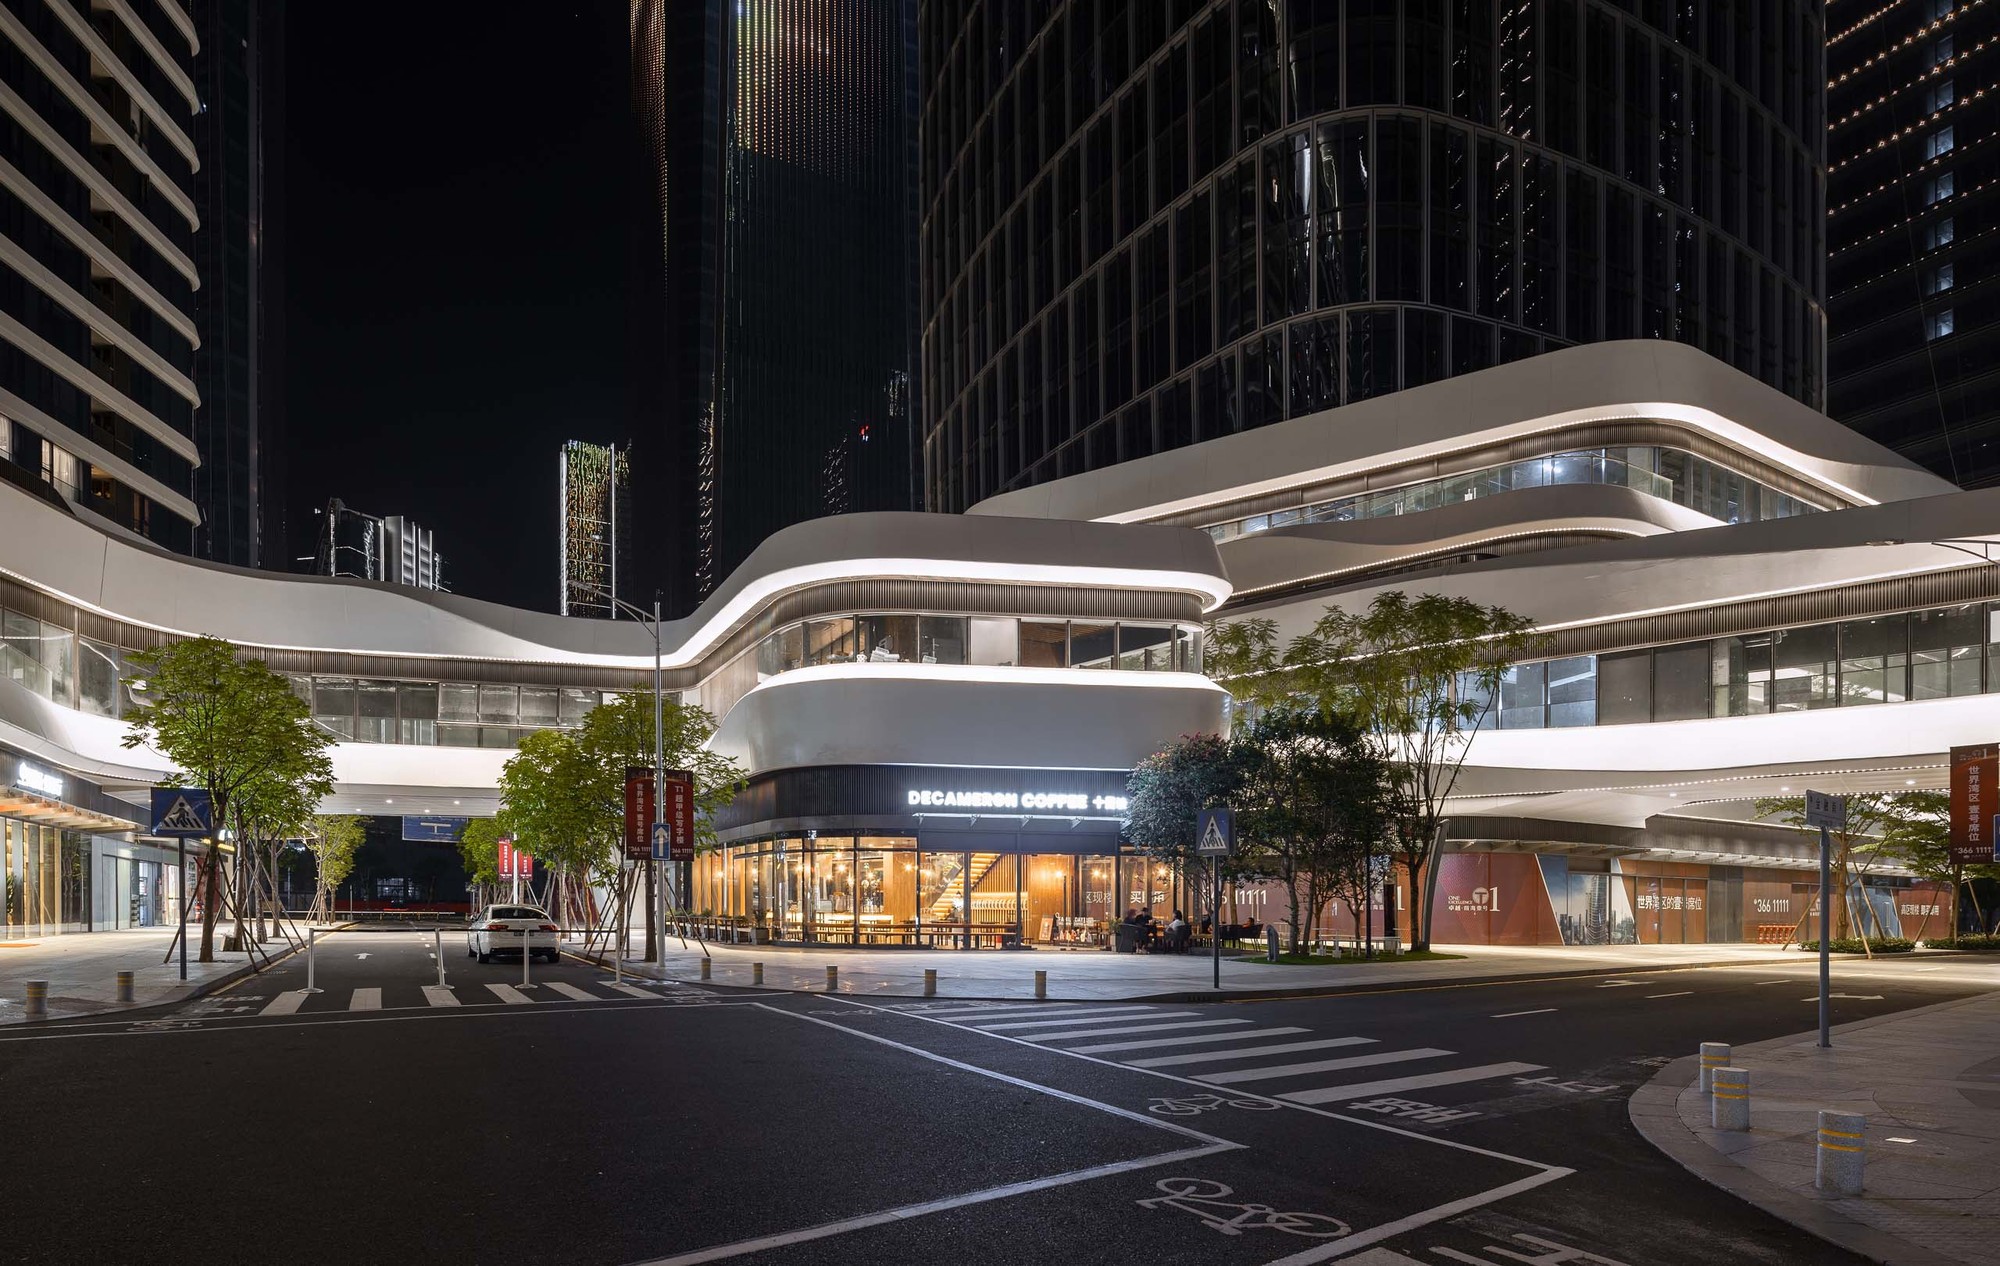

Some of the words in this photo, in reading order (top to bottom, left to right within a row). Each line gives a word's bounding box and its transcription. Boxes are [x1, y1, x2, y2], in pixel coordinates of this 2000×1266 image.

[1968, 765, 1980, 802] 世界湾区
[908, 791, 1018, 808] DECAMERON
[1021, 792, 1088, 810] COFFEE
[1968, 805, 1980, 842] 壹号席位
[1958, 846, 1973, 855] 366
[1757, 898, 1771, 913] 366
[1772, 899, 1789, 913] 11111
